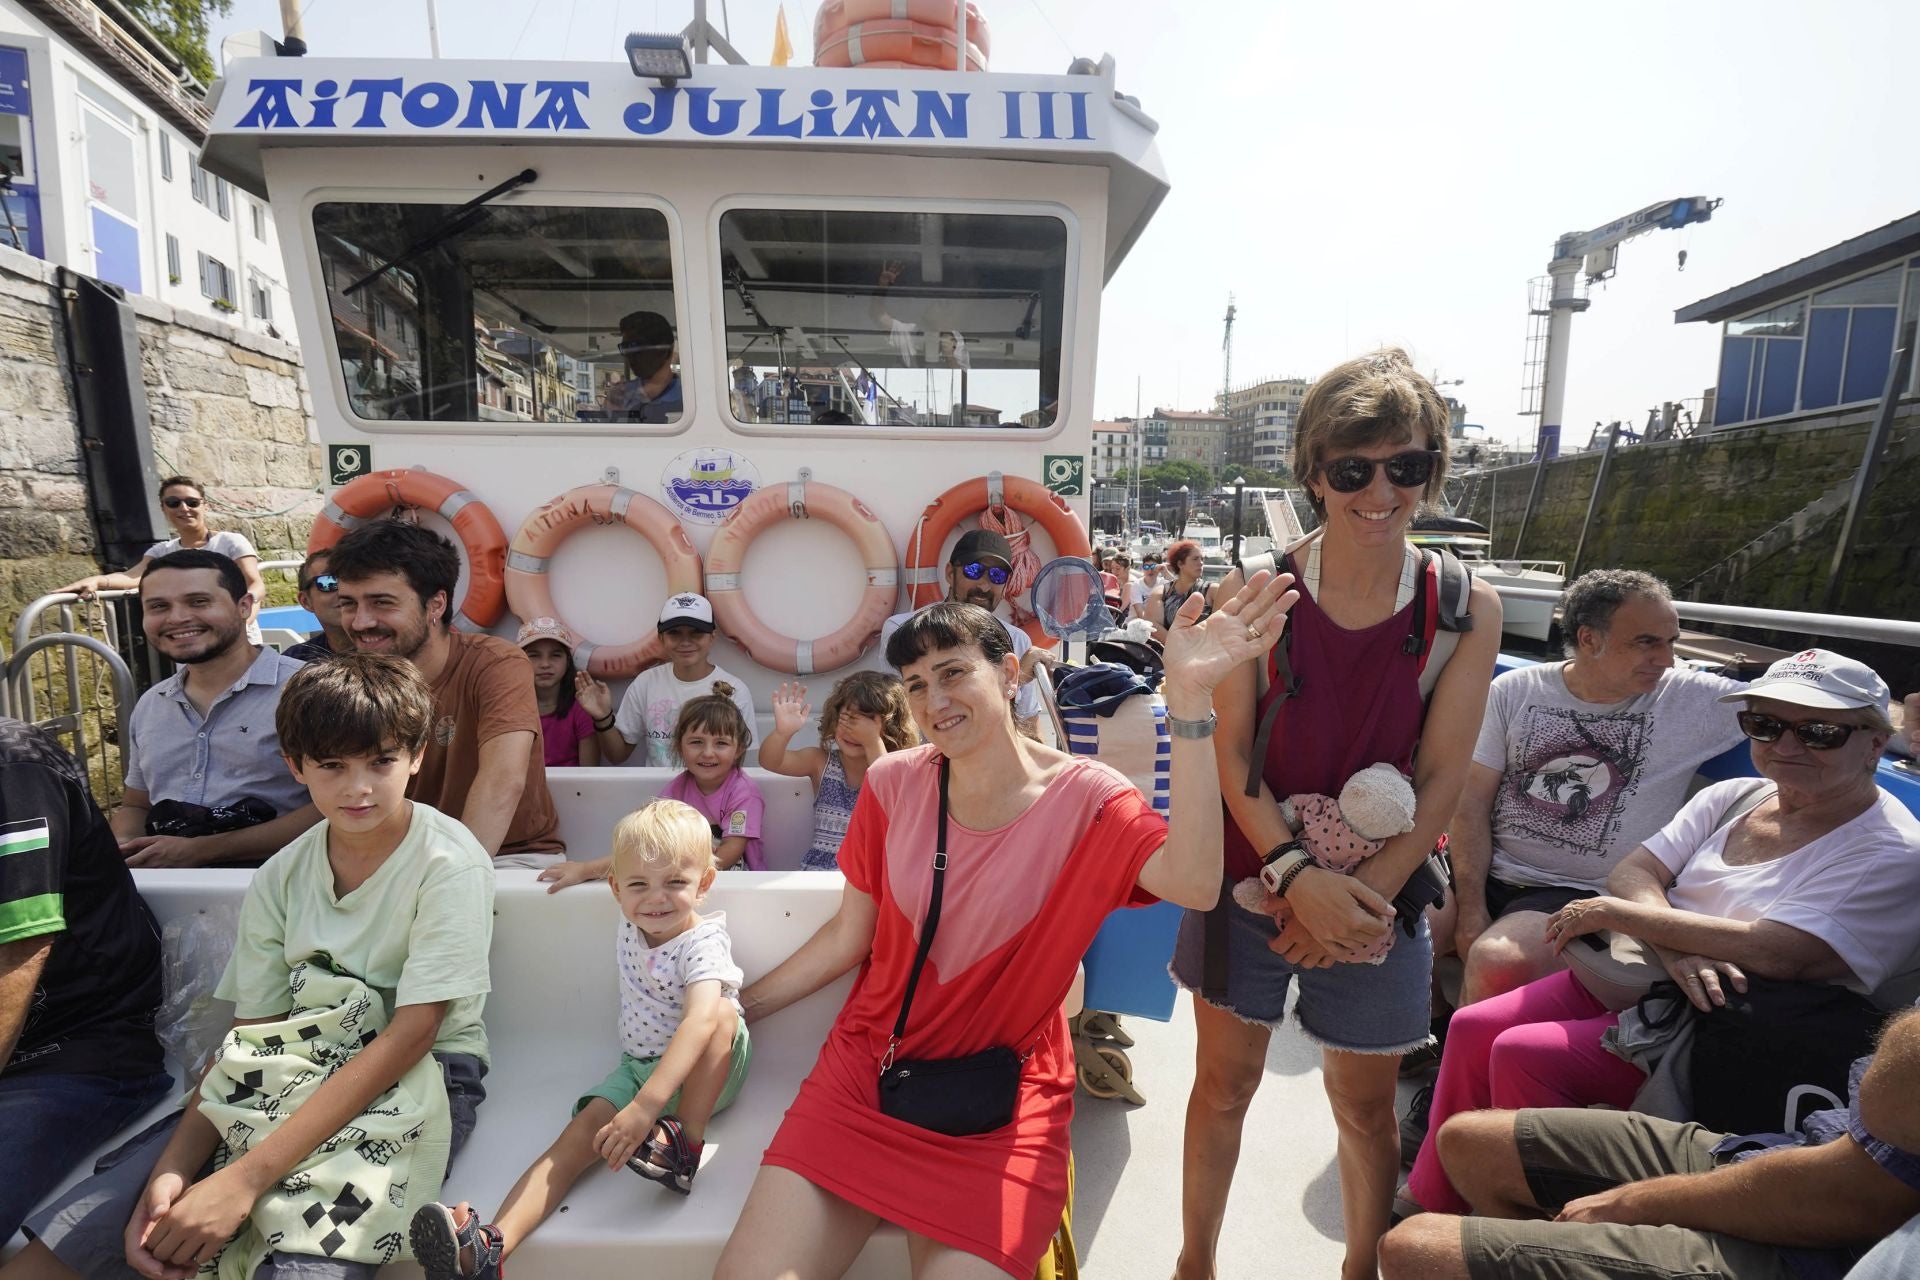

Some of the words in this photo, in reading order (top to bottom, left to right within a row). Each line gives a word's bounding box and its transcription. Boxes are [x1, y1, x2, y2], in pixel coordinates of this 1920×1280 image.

[997, 90, 1096, 140] III
[684, 505, 692, 513] de
[685, 489, 740, 505] ab
[522, 499, 594, 543] AITONA
